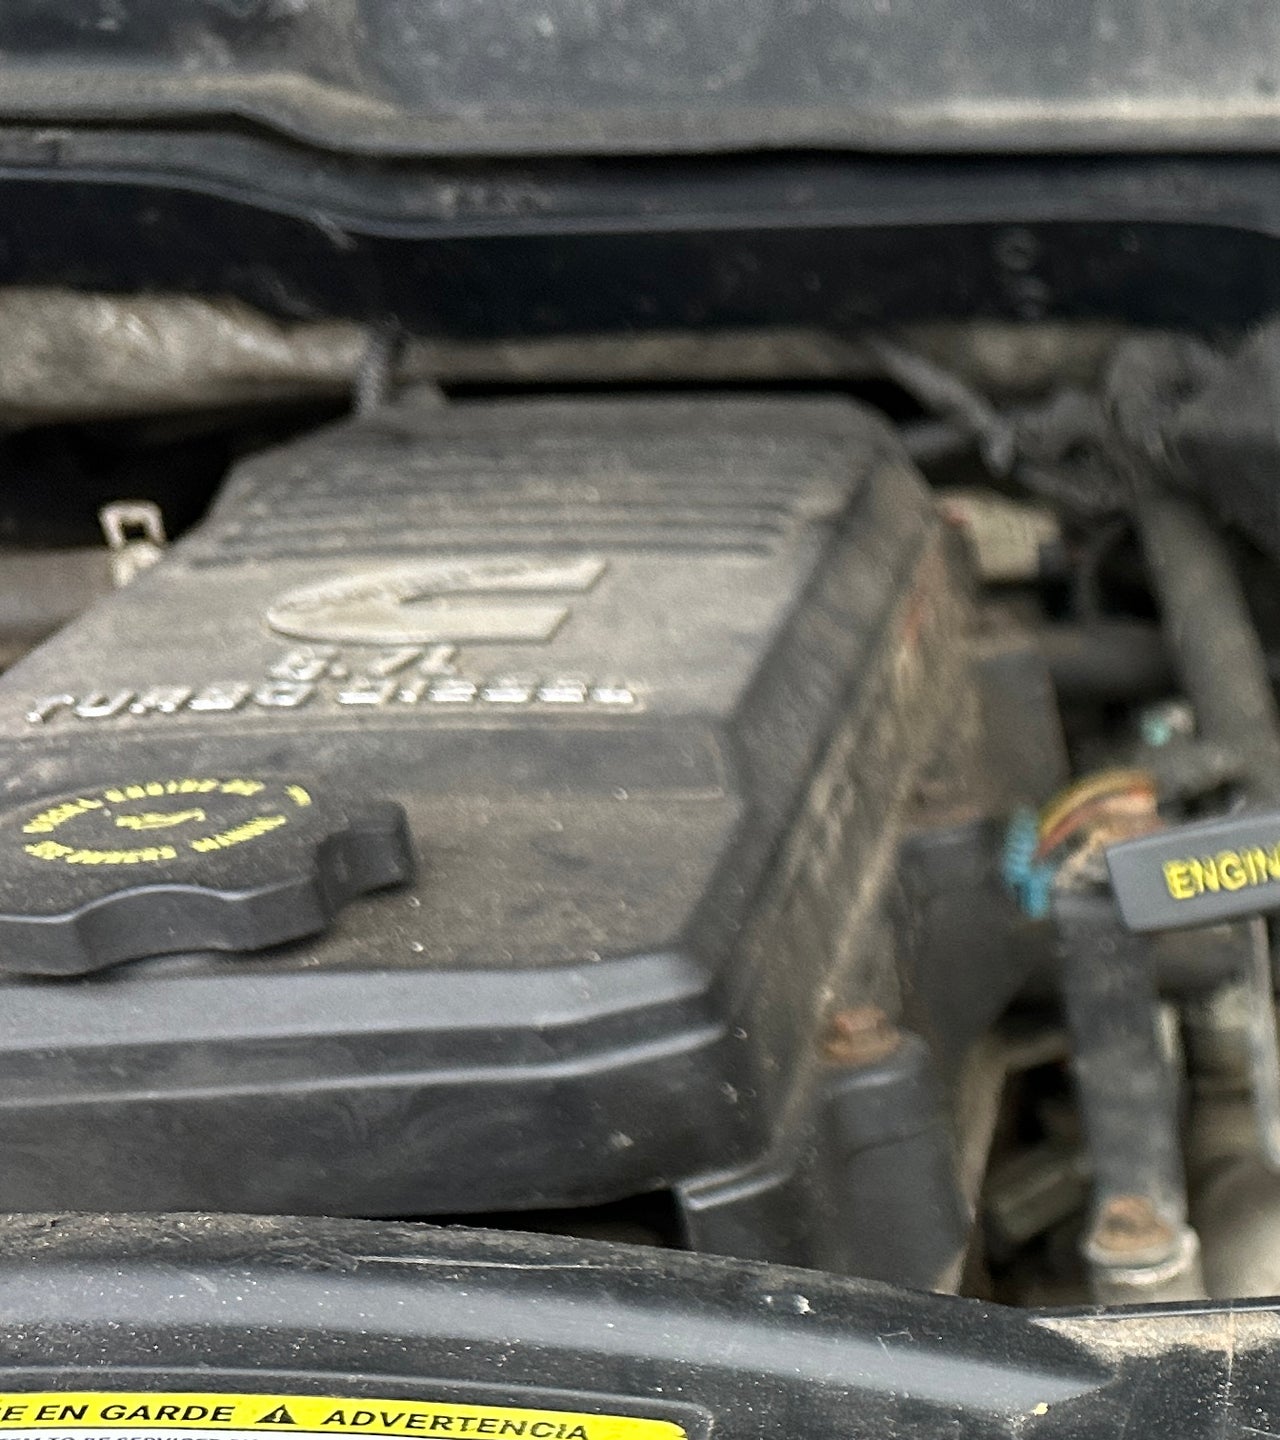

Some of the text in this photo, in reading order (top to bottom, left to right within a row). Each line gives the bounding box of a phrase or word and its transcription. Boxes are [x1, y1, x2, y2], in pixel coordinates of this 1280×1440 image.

[34, 1404, 90, 1422] EN
[99, 1404, 236, 1423] GARDE
[320, 1409, 590, 1440] ADVERTENCIA
